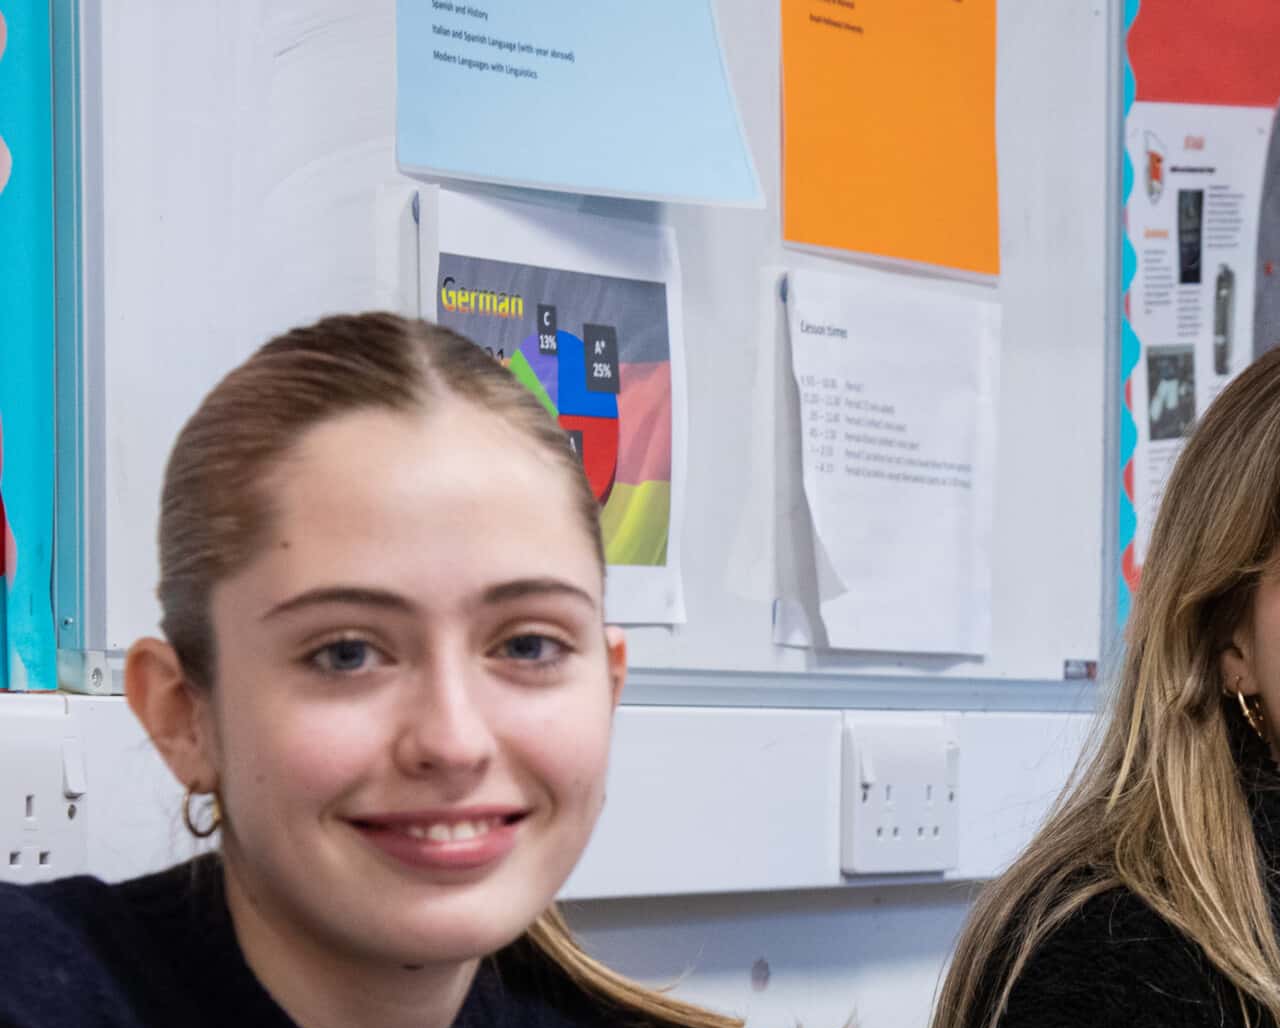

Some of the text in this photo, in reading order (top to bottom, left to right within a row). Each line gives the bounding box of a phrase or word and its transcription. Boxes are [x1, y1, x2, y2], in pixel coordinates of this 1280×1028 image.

[456, 5, 465, 15] and
[467, 7, 488, 21] History
[432, 24, 450, 36] Italian
[452, 30, 463, 39] and
[464, 31, 487, 44] Spanish
[488, 36, 516, 52] Language
[433, 50, 538, 79] Modern Languages with Linguistics
[442, 276, 524, 320] German
[543, 311, 550, 326] C
[539, 335, 557, 350] 13%
[592, 362, 612, 379] 25%
